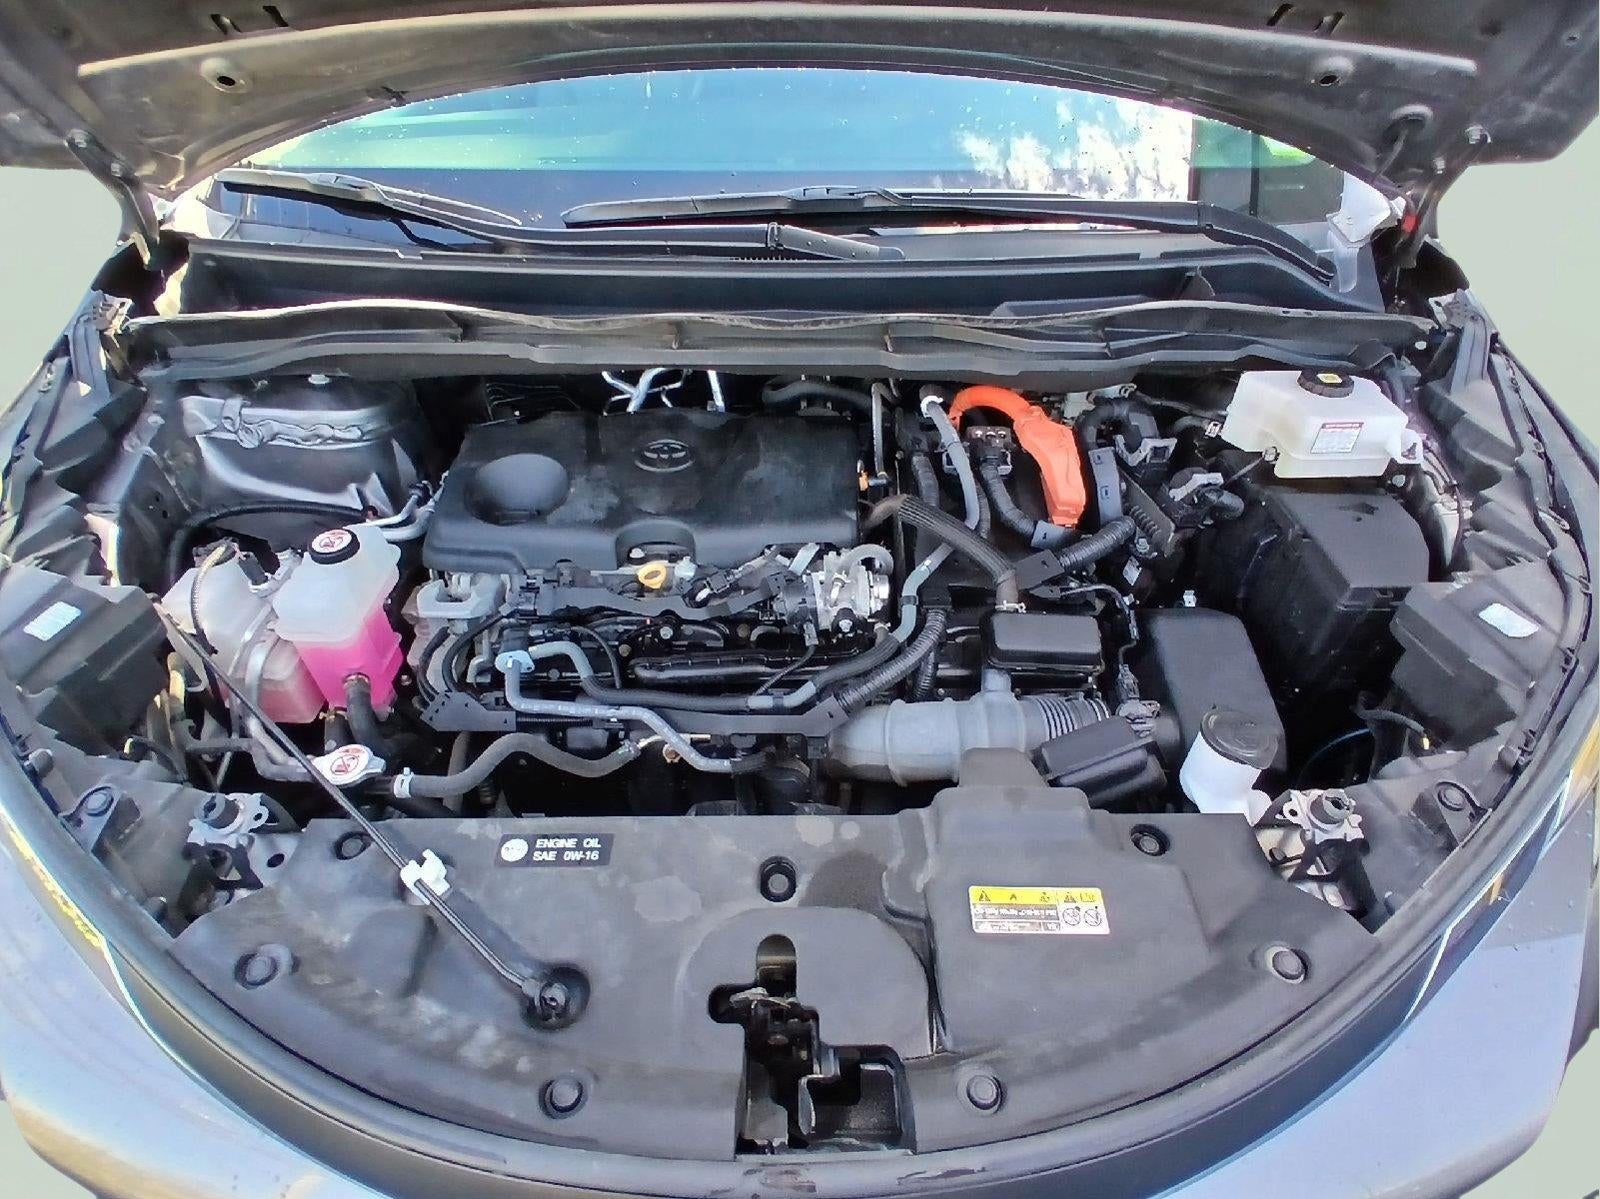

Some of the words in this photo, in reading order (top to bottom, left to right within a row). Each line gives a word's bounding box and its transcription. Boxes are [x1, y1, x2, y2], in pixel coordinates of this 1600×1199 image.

[535, 838, 578, 848] ENGINE
[583, 837, 602, 848] OIL
[533, 850, 557, 861] SAE
[563, 850, 600, 861] 0W-16
